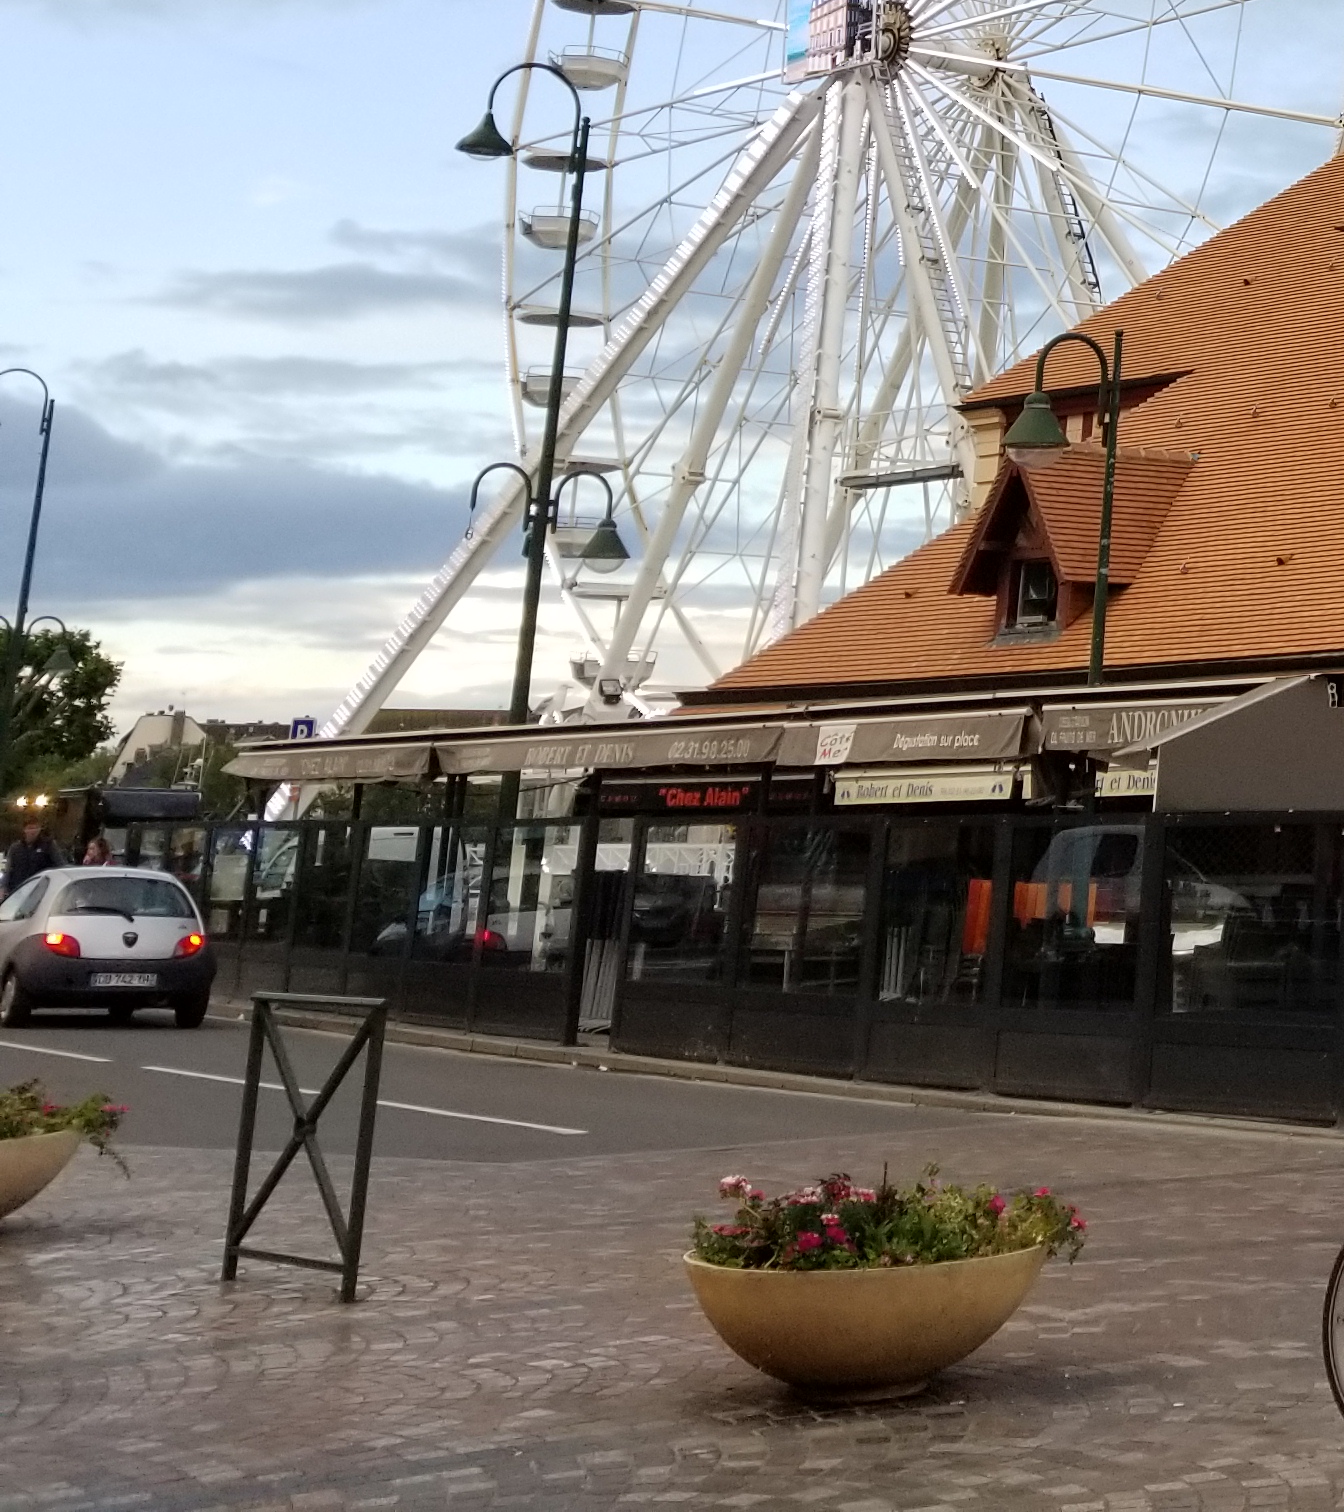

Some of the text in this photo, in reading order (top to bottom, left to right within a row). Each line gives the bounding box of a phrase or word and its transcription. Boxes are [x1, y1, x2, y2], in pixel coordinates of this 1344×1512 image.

[892, 730, 980, 751] Dégustation sur place
[524, 737, 750, 766] ROBERT ET DENIS 02.31.98.25.00
[659, 787, 699, 808] "Chez
[703, 786, 749, 807] Alain"
[856, 781, 889, 799] Robert
[892, 782, 902, 798] et
[906, 780, 934, 798] Denis
